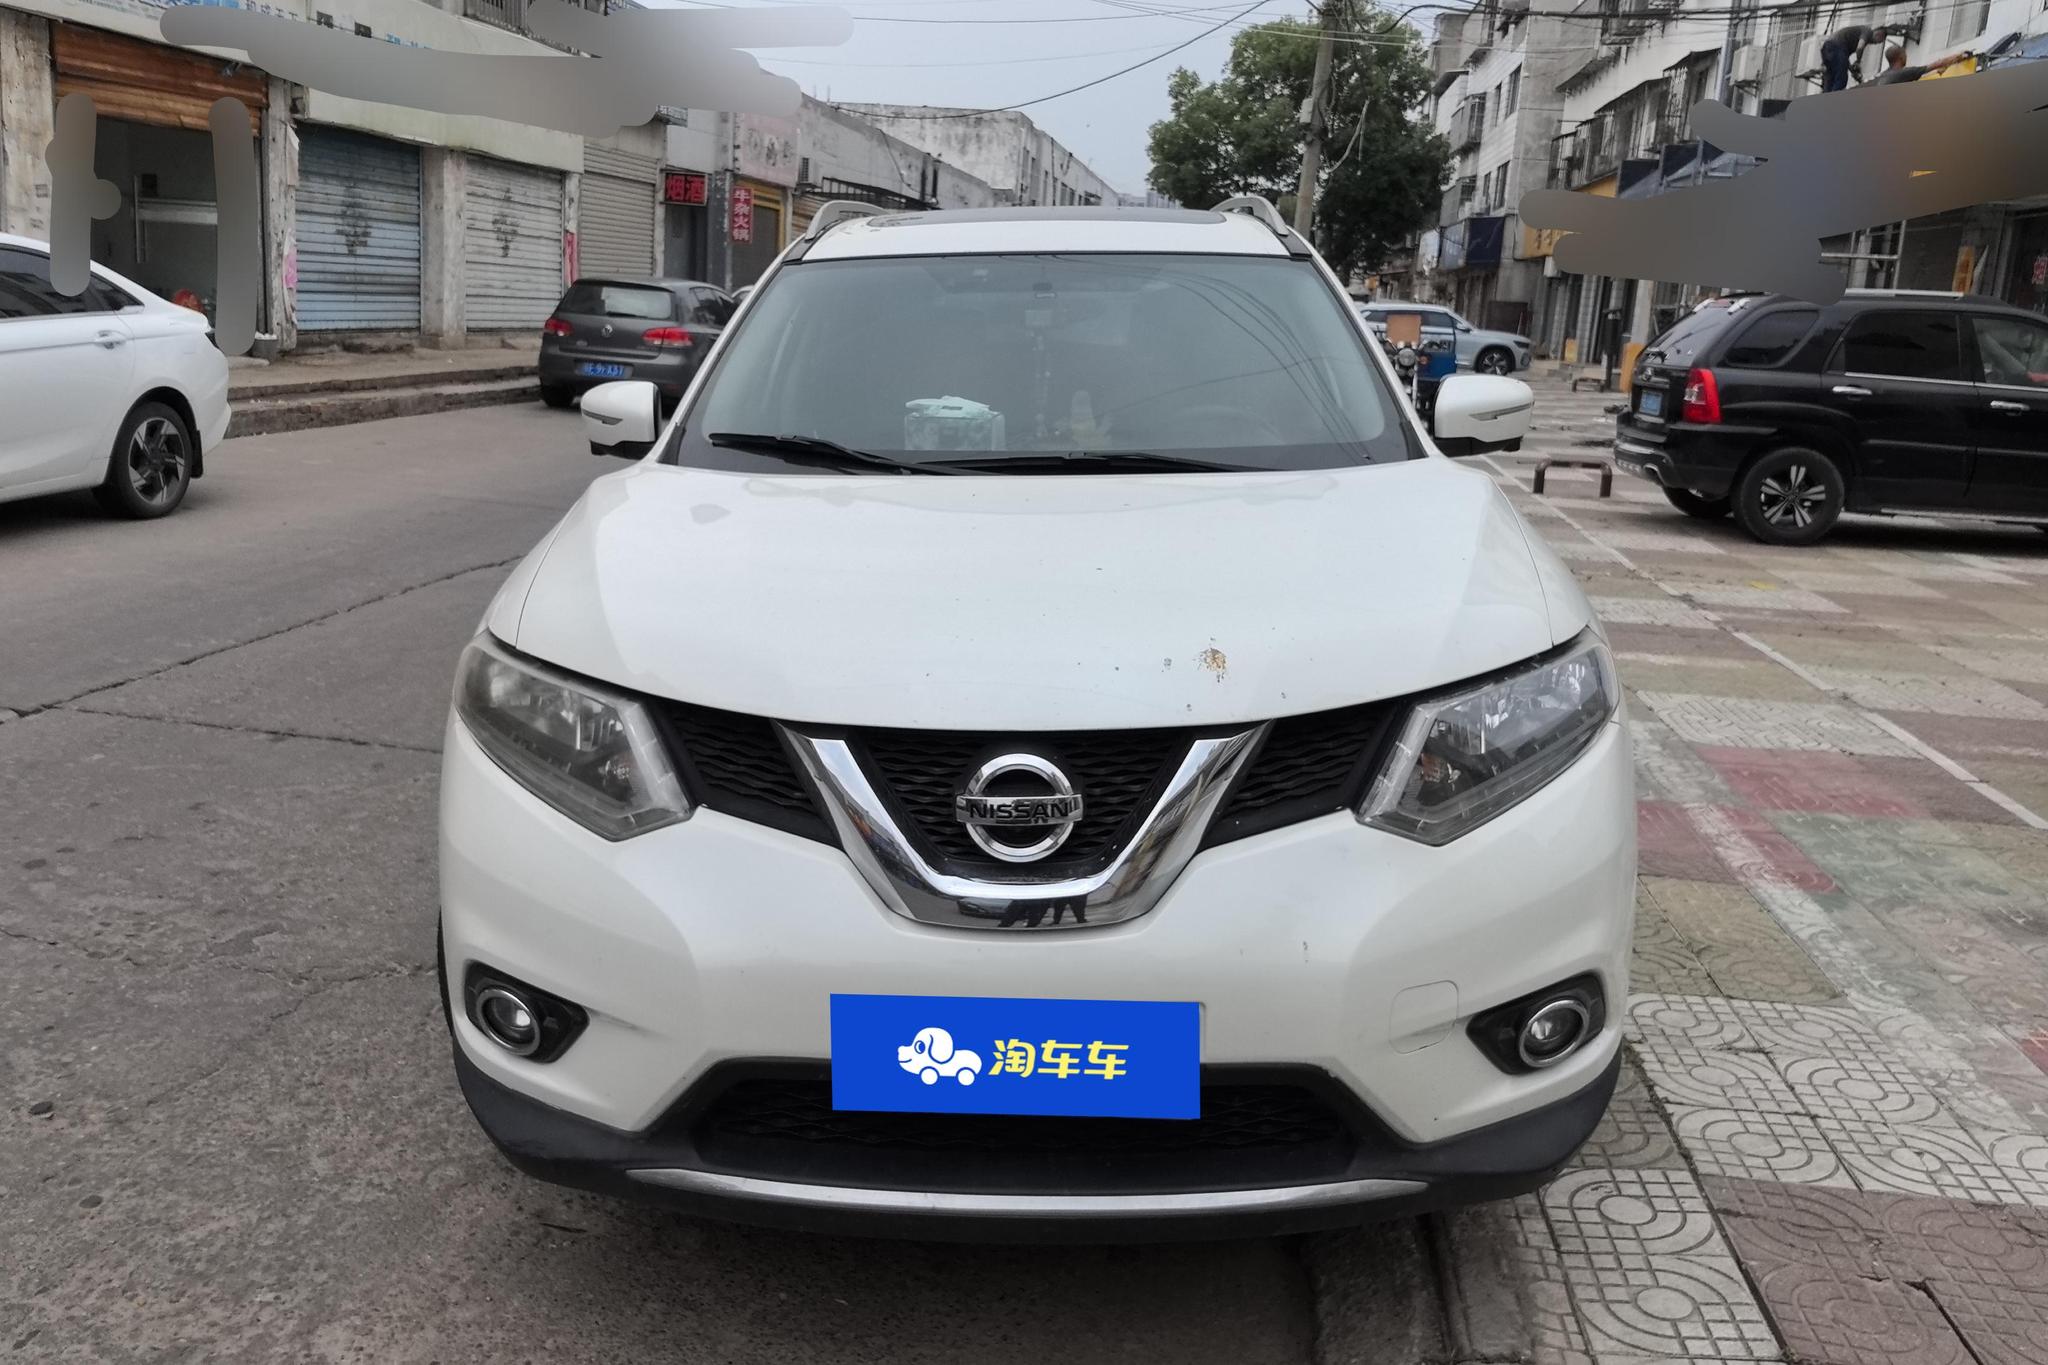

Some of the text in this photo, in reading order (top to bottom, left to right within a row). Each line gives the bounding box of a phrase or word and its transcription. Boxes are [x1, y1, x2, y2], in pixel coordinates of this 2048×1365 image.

[666, 174, 705, 203] 烟酒
[732, 189, 751, 241] 牛杂火锅
[969, 802, 1070, 819] NISSAN
